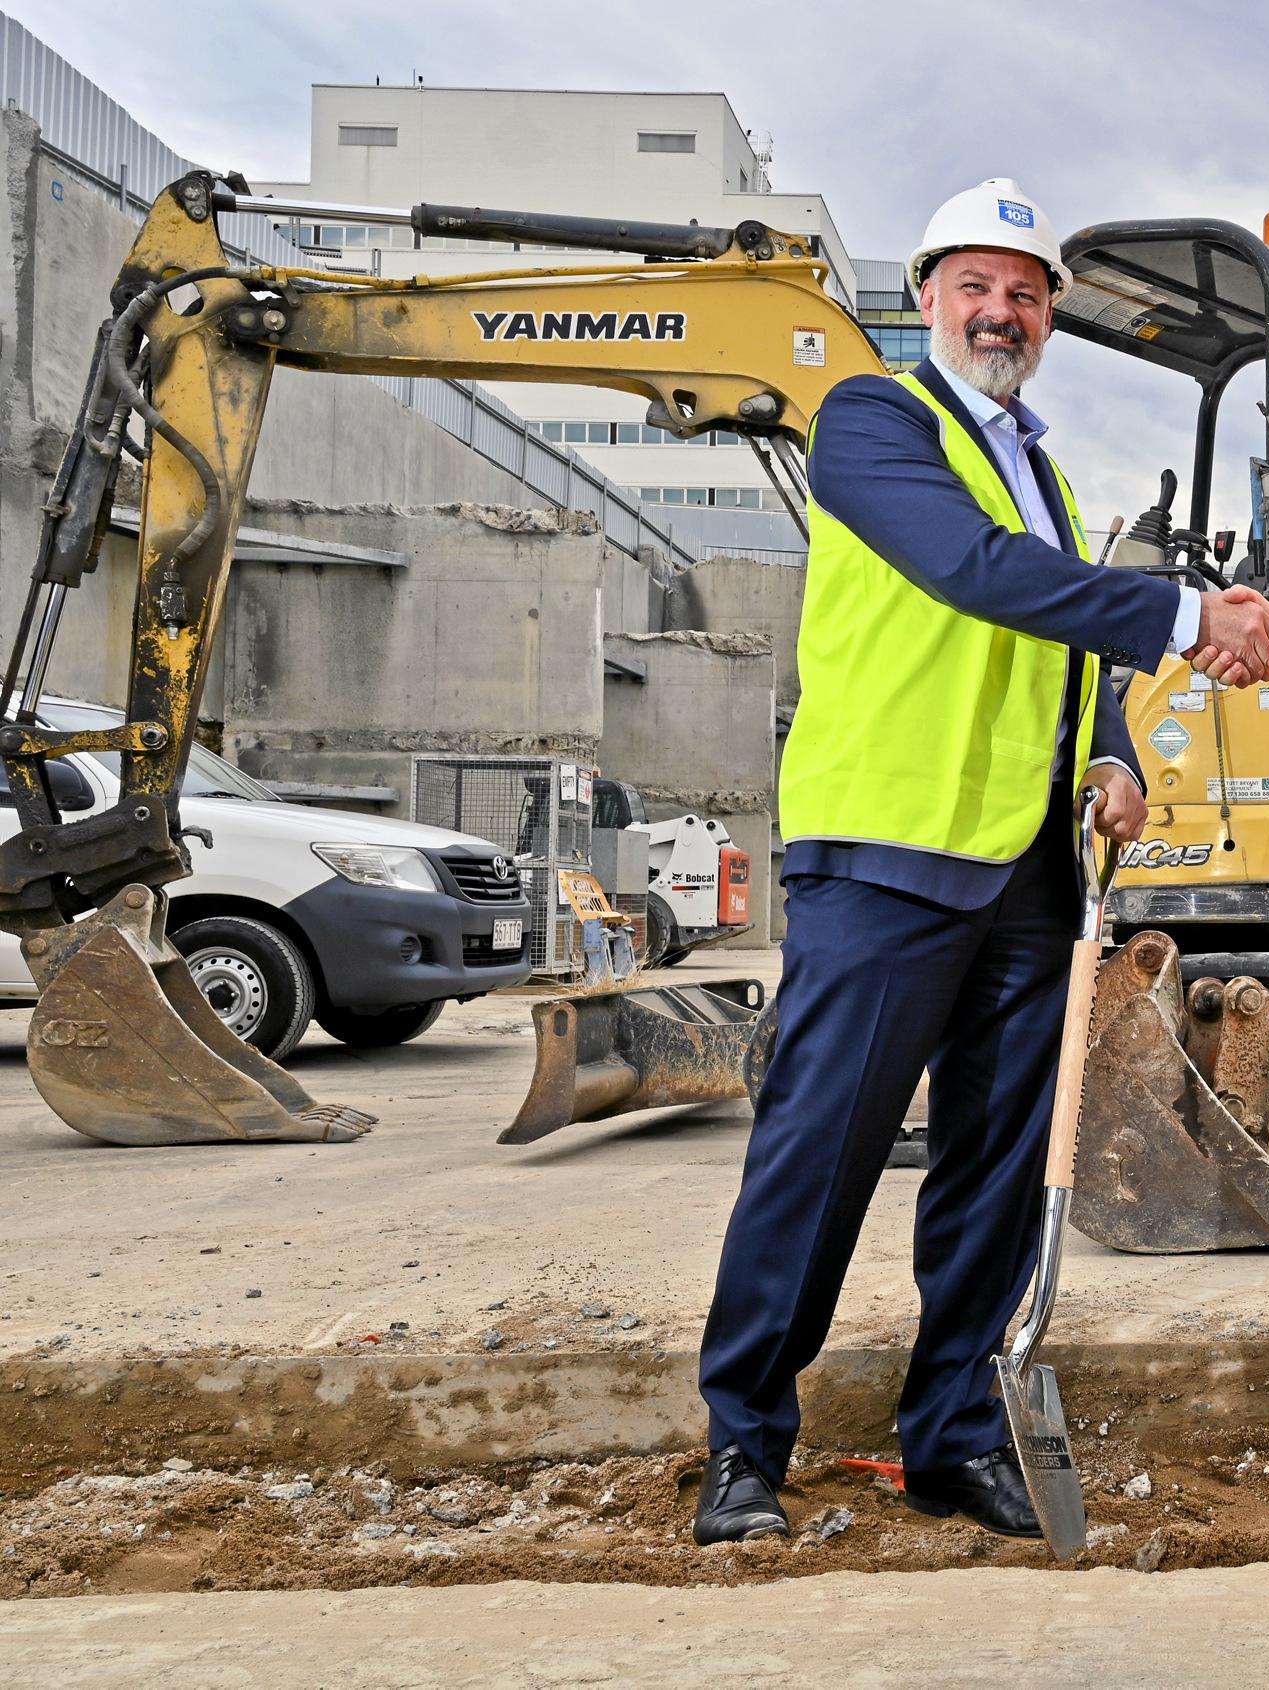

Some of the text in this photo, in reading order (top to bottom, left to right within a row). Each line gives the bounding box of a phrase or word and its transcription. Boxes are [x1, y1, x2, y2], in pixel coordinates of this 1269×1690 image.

[1005, 210, 1030, 224] 105
[472, 312, 686, 340] YANMAR
[686, 874, 715, 883] Bobcat
